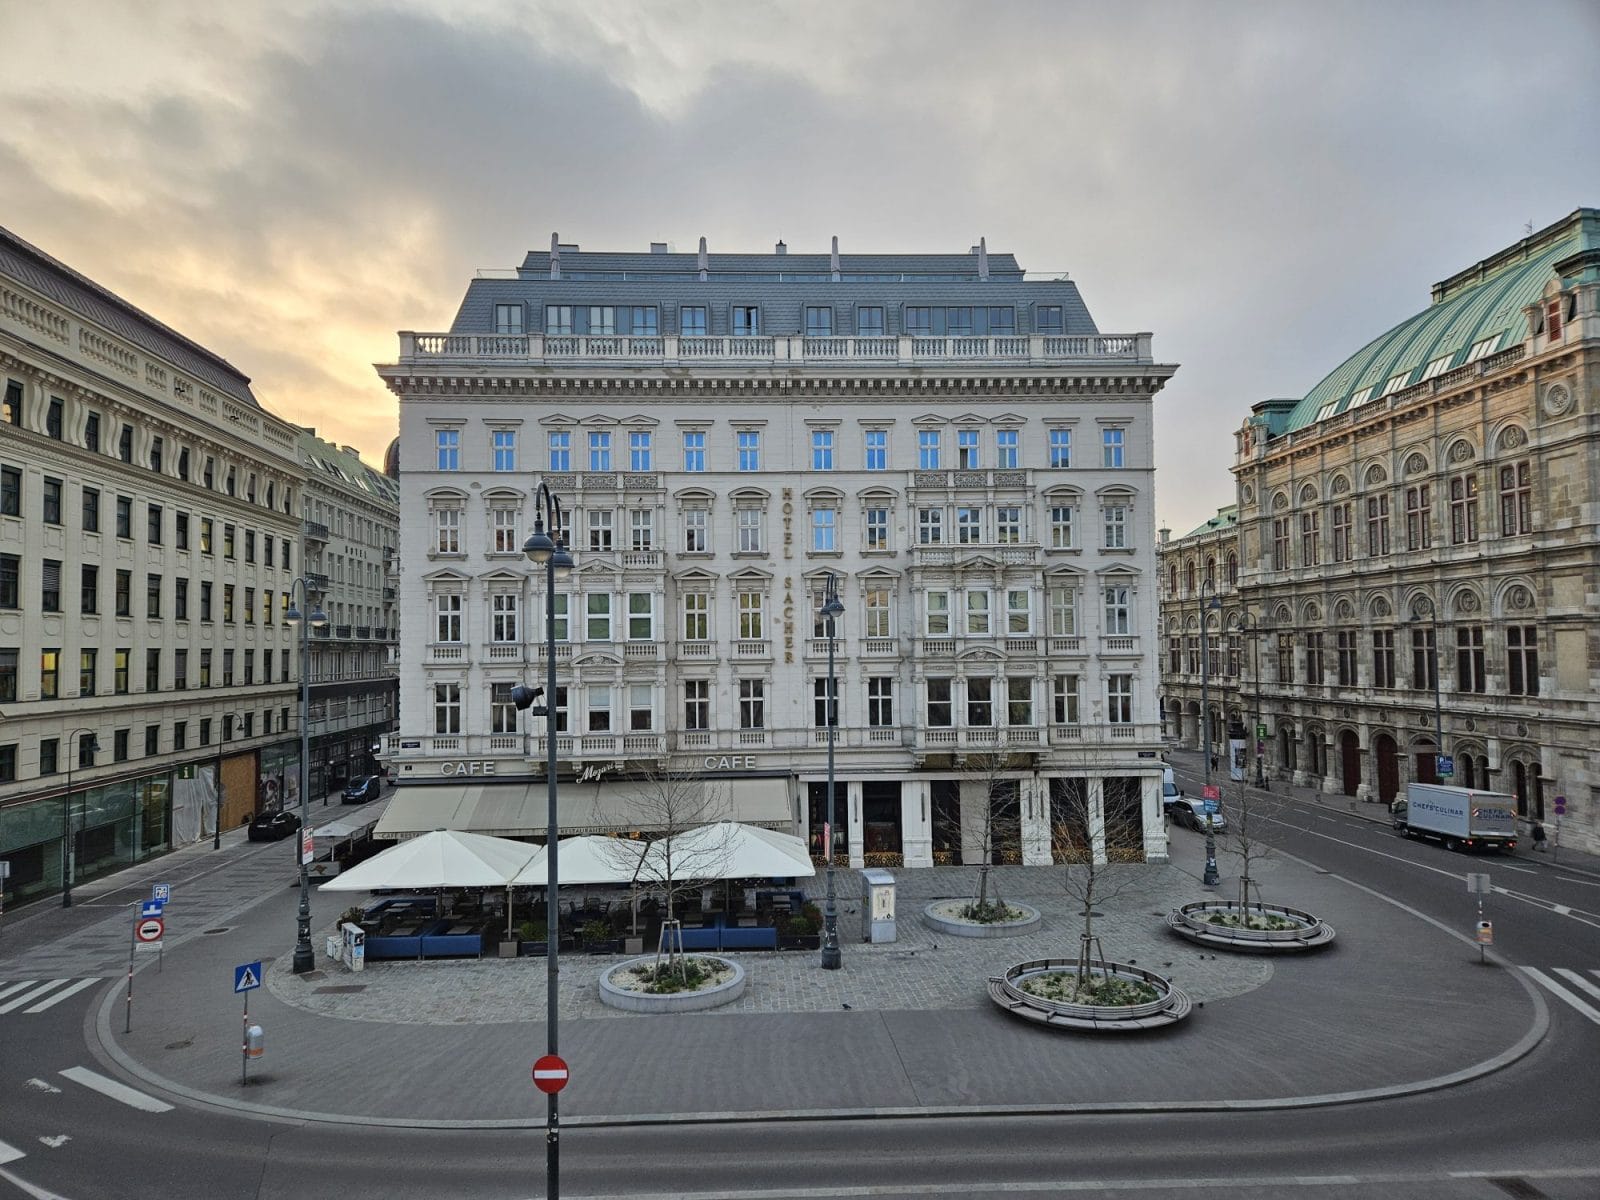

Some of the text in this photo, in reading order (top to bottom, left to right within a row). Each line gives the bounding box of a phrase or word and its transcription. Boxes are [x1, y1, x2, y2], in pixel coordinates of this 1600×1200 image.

[782, 487, 794, 664] HOTEL SACHER
[440, 761, 495, 776] CAFE
[704, 755, 756, 769] CAFE
